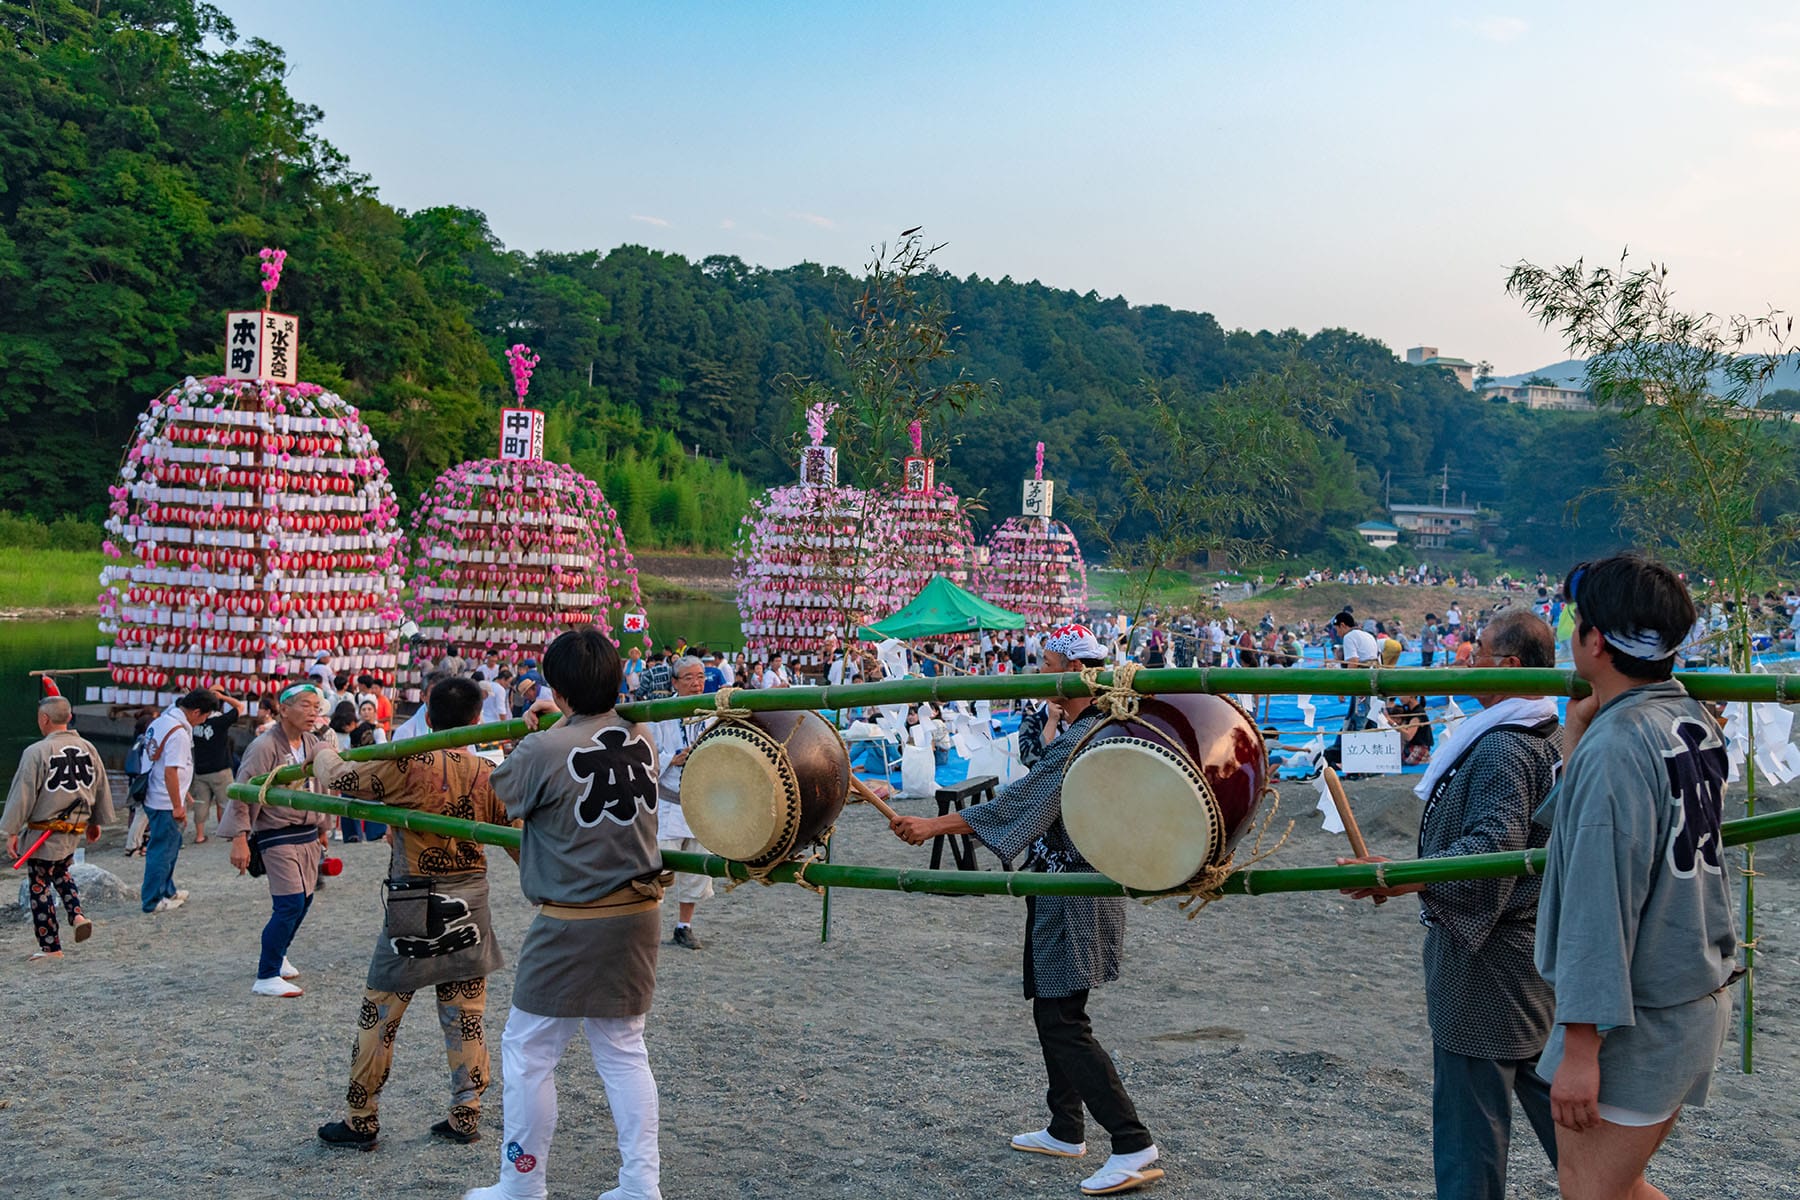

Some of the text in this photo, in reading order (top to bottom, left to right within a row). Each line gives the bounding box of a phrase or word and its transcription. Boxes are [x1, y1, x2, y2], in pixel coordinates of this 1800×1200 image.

[231, 318, 256, 374] 本町
[270, 329, 289, 378] 水天宮
[504, 412, 529, 458] 中町
[45, 746, 95, 793] 本
[1346, 743, 1396, 756] 立入禁止
[567, 726, 659, 828] 本
